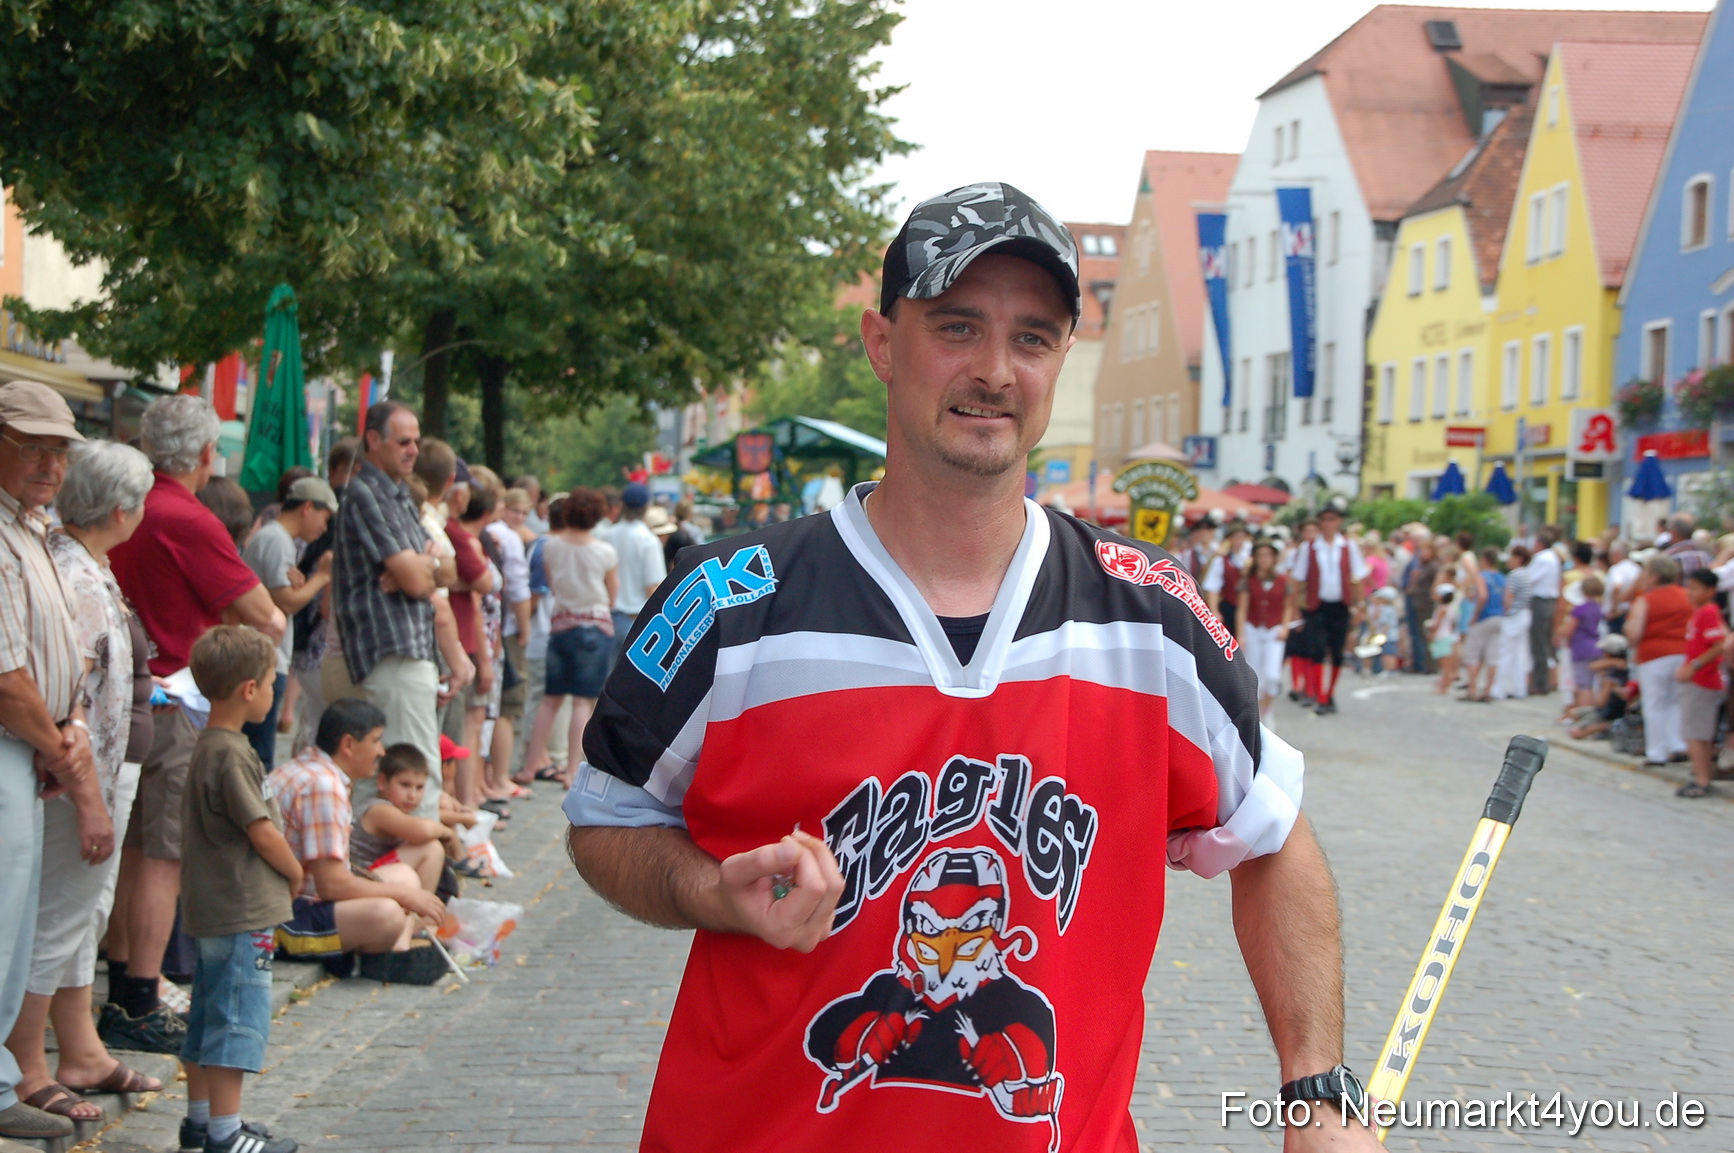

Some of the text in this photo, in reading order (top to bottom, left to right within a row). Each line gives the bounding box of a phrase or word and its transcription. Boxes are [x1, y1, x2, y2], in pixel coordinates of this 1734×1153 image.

[626, 544, 778, 686] PSK
[727, 584, 774, 606] KOLLAR
[1143, 572, 1226, 647] BREITENBRUNN
[1382, 849, 1491, 1077] KOHO
